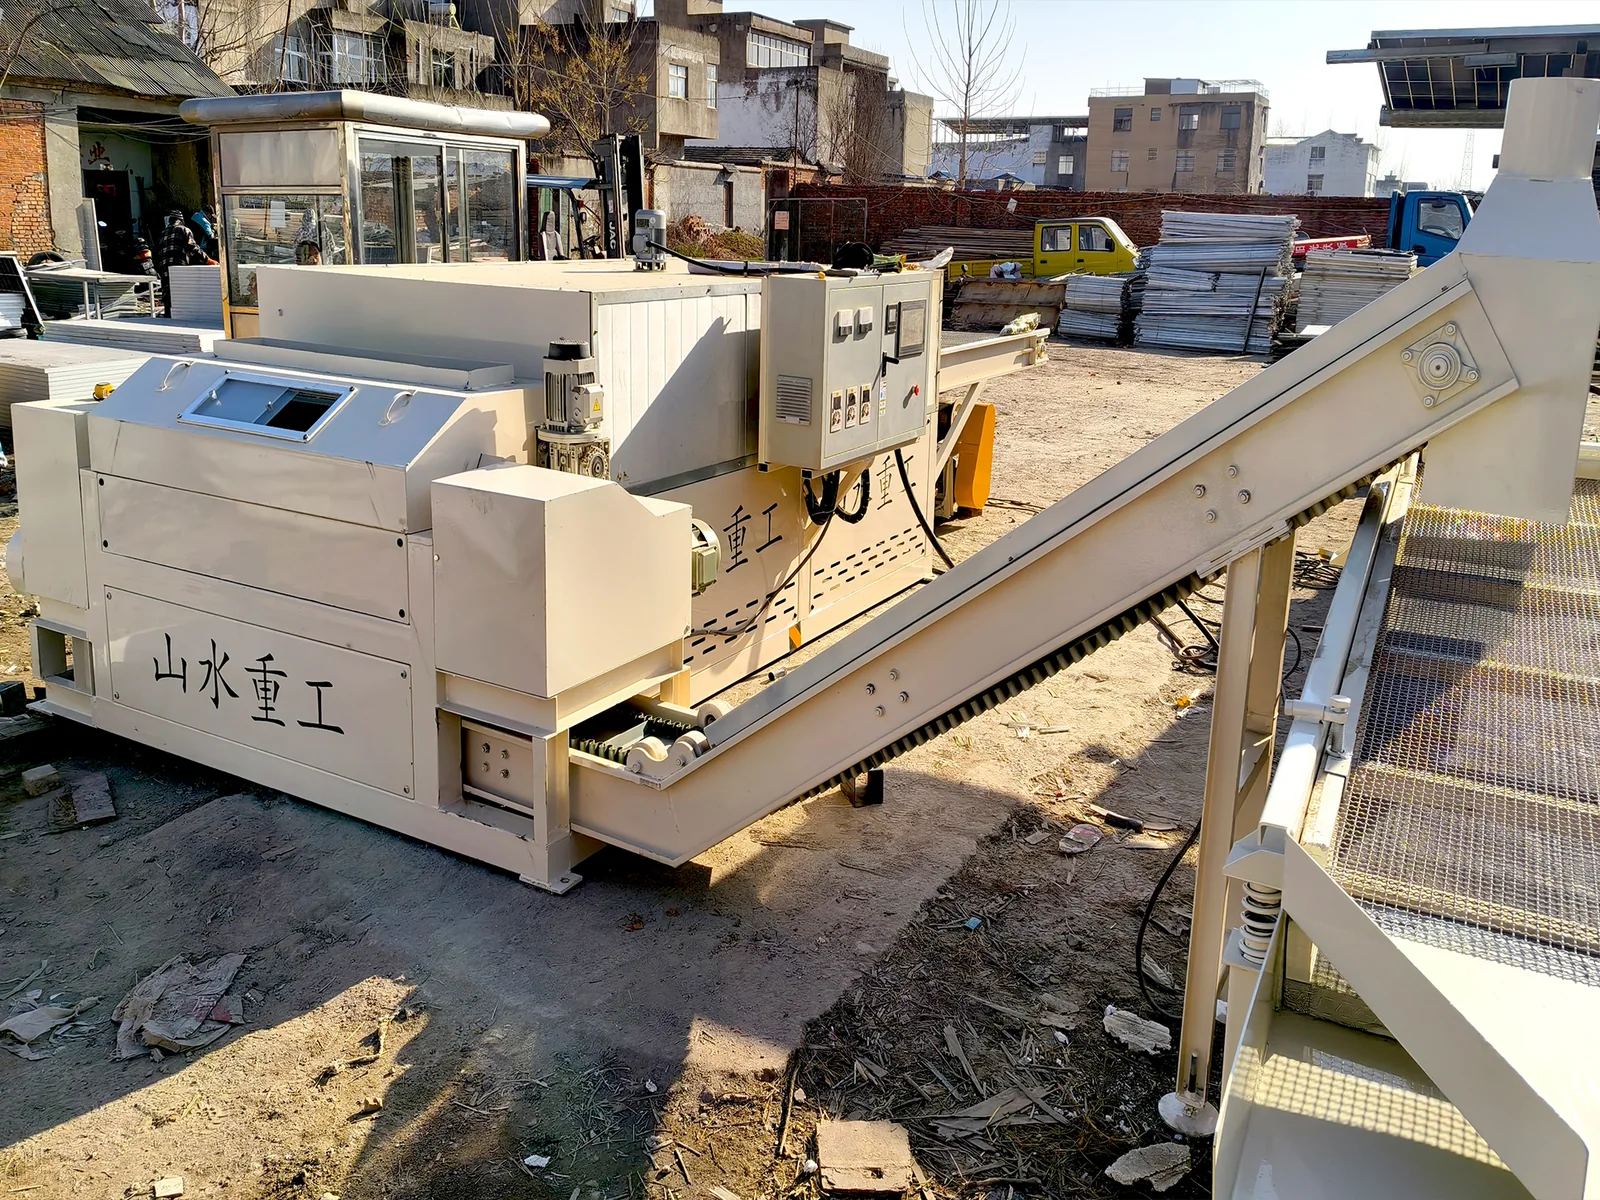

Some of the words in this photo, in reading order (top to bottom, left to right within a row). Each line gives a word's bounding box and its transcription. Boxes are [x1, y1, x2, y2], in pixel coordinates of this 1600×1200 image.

[723, 503, 782, 573] 重工
[153, 632, 345, 735] 山水重工
